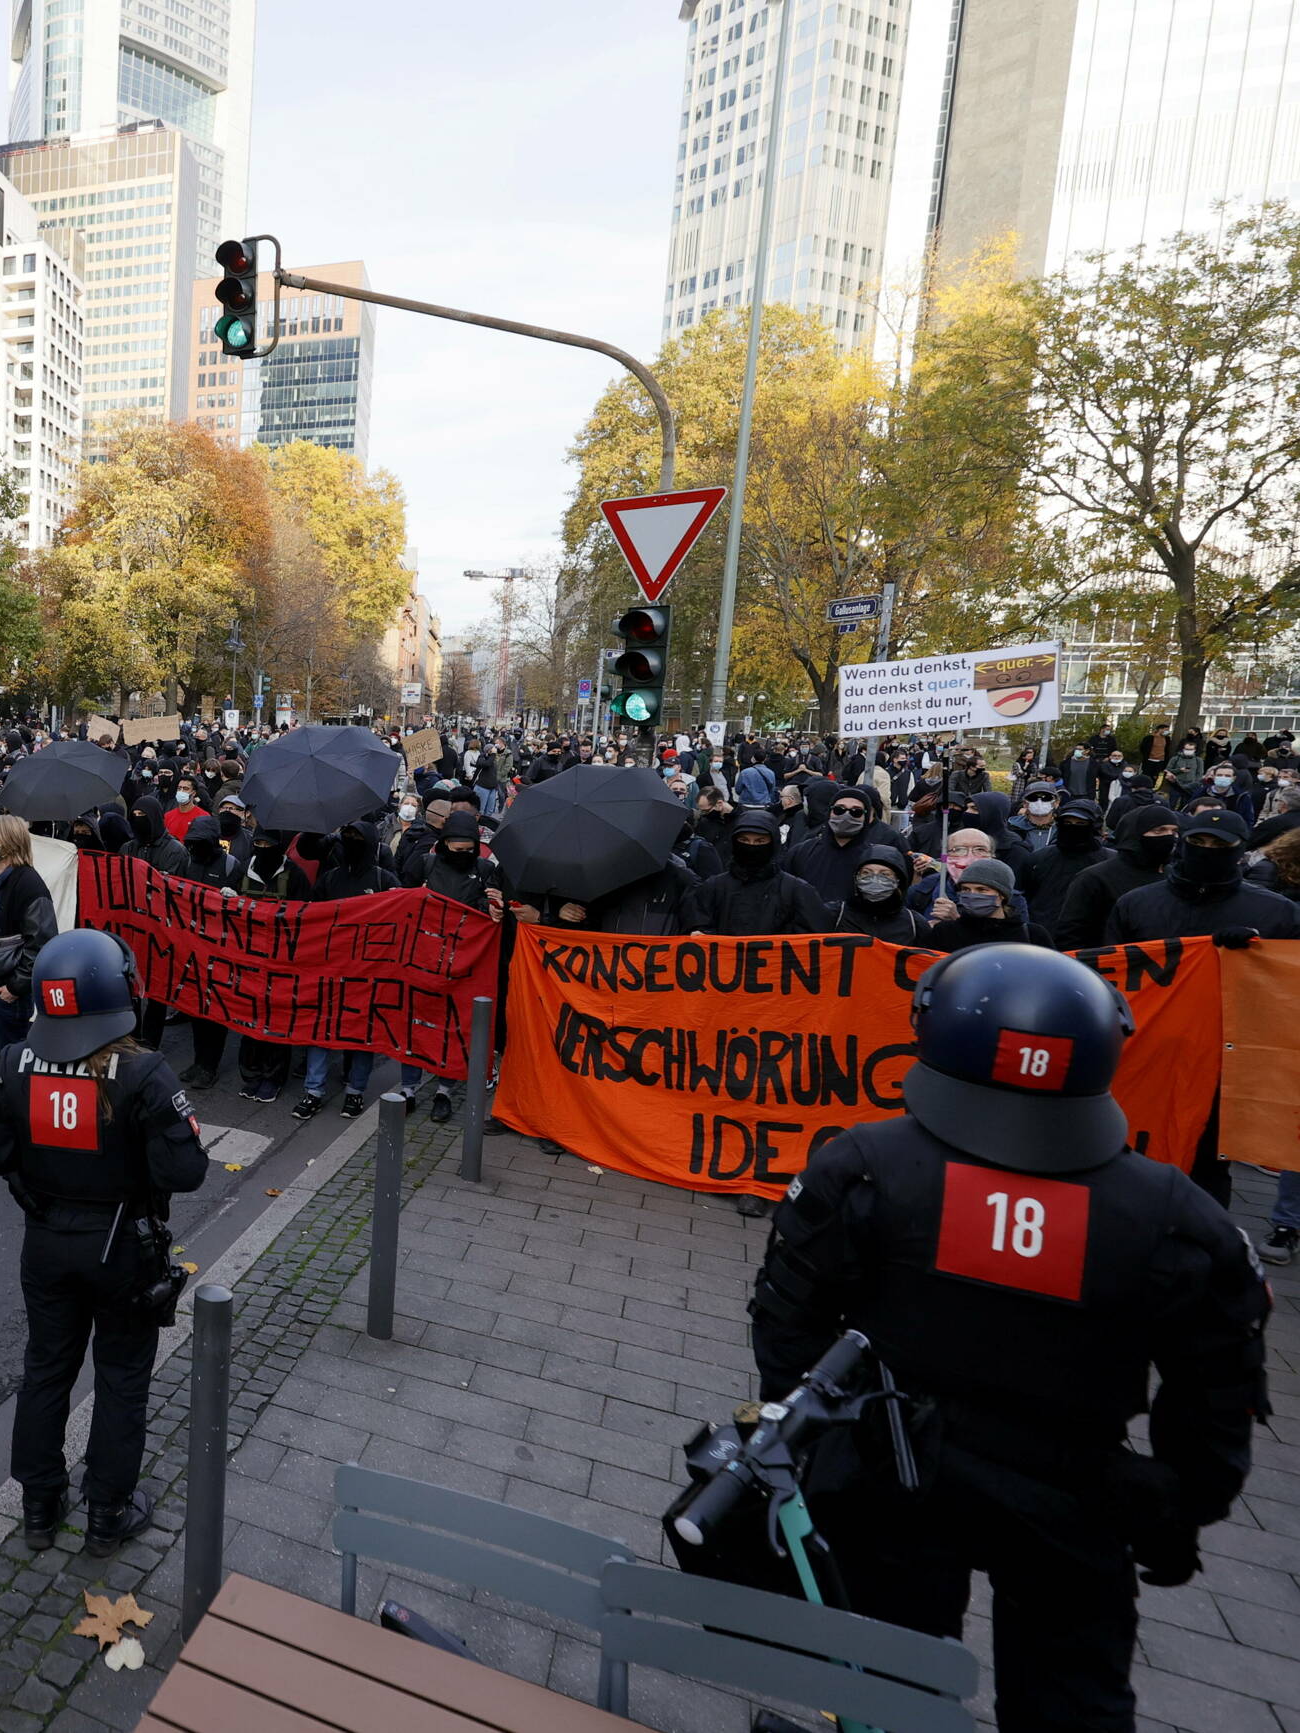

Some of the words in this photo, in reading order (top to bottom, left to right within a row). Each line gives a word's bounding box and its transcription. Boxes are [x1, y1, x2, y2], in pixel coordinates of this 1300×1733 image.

[835, 603, 870, 615] Gallusanlage
[844, 666, 886, 680] Wenn
[891, 664, 910, 677] du
[914, 658, 971, 675] denkst,
[844, 684, 863, 697] du
[868, 680, 924, 696] denkst
[844, 701, 875, 715] dann
[879, 698, 923, 713] denkst
[925, 696, 942, 709] du
[945, 694, 972, 708] nur,
[844, 719, 863, 732] du
[868, 714, 923, 730] denkst
[927, 712, 971, 729] quer!
[82, 850, 306, 962] TOLERIEREN
[539, 935, 874, 997] KONSEQUENT
[49, 987, 66, 1008] 18
[1018, 1046, 1051, 1078] 18
[50, 1090, 78, 1130] 18
[985, 1190, 1046, 1259] 18
